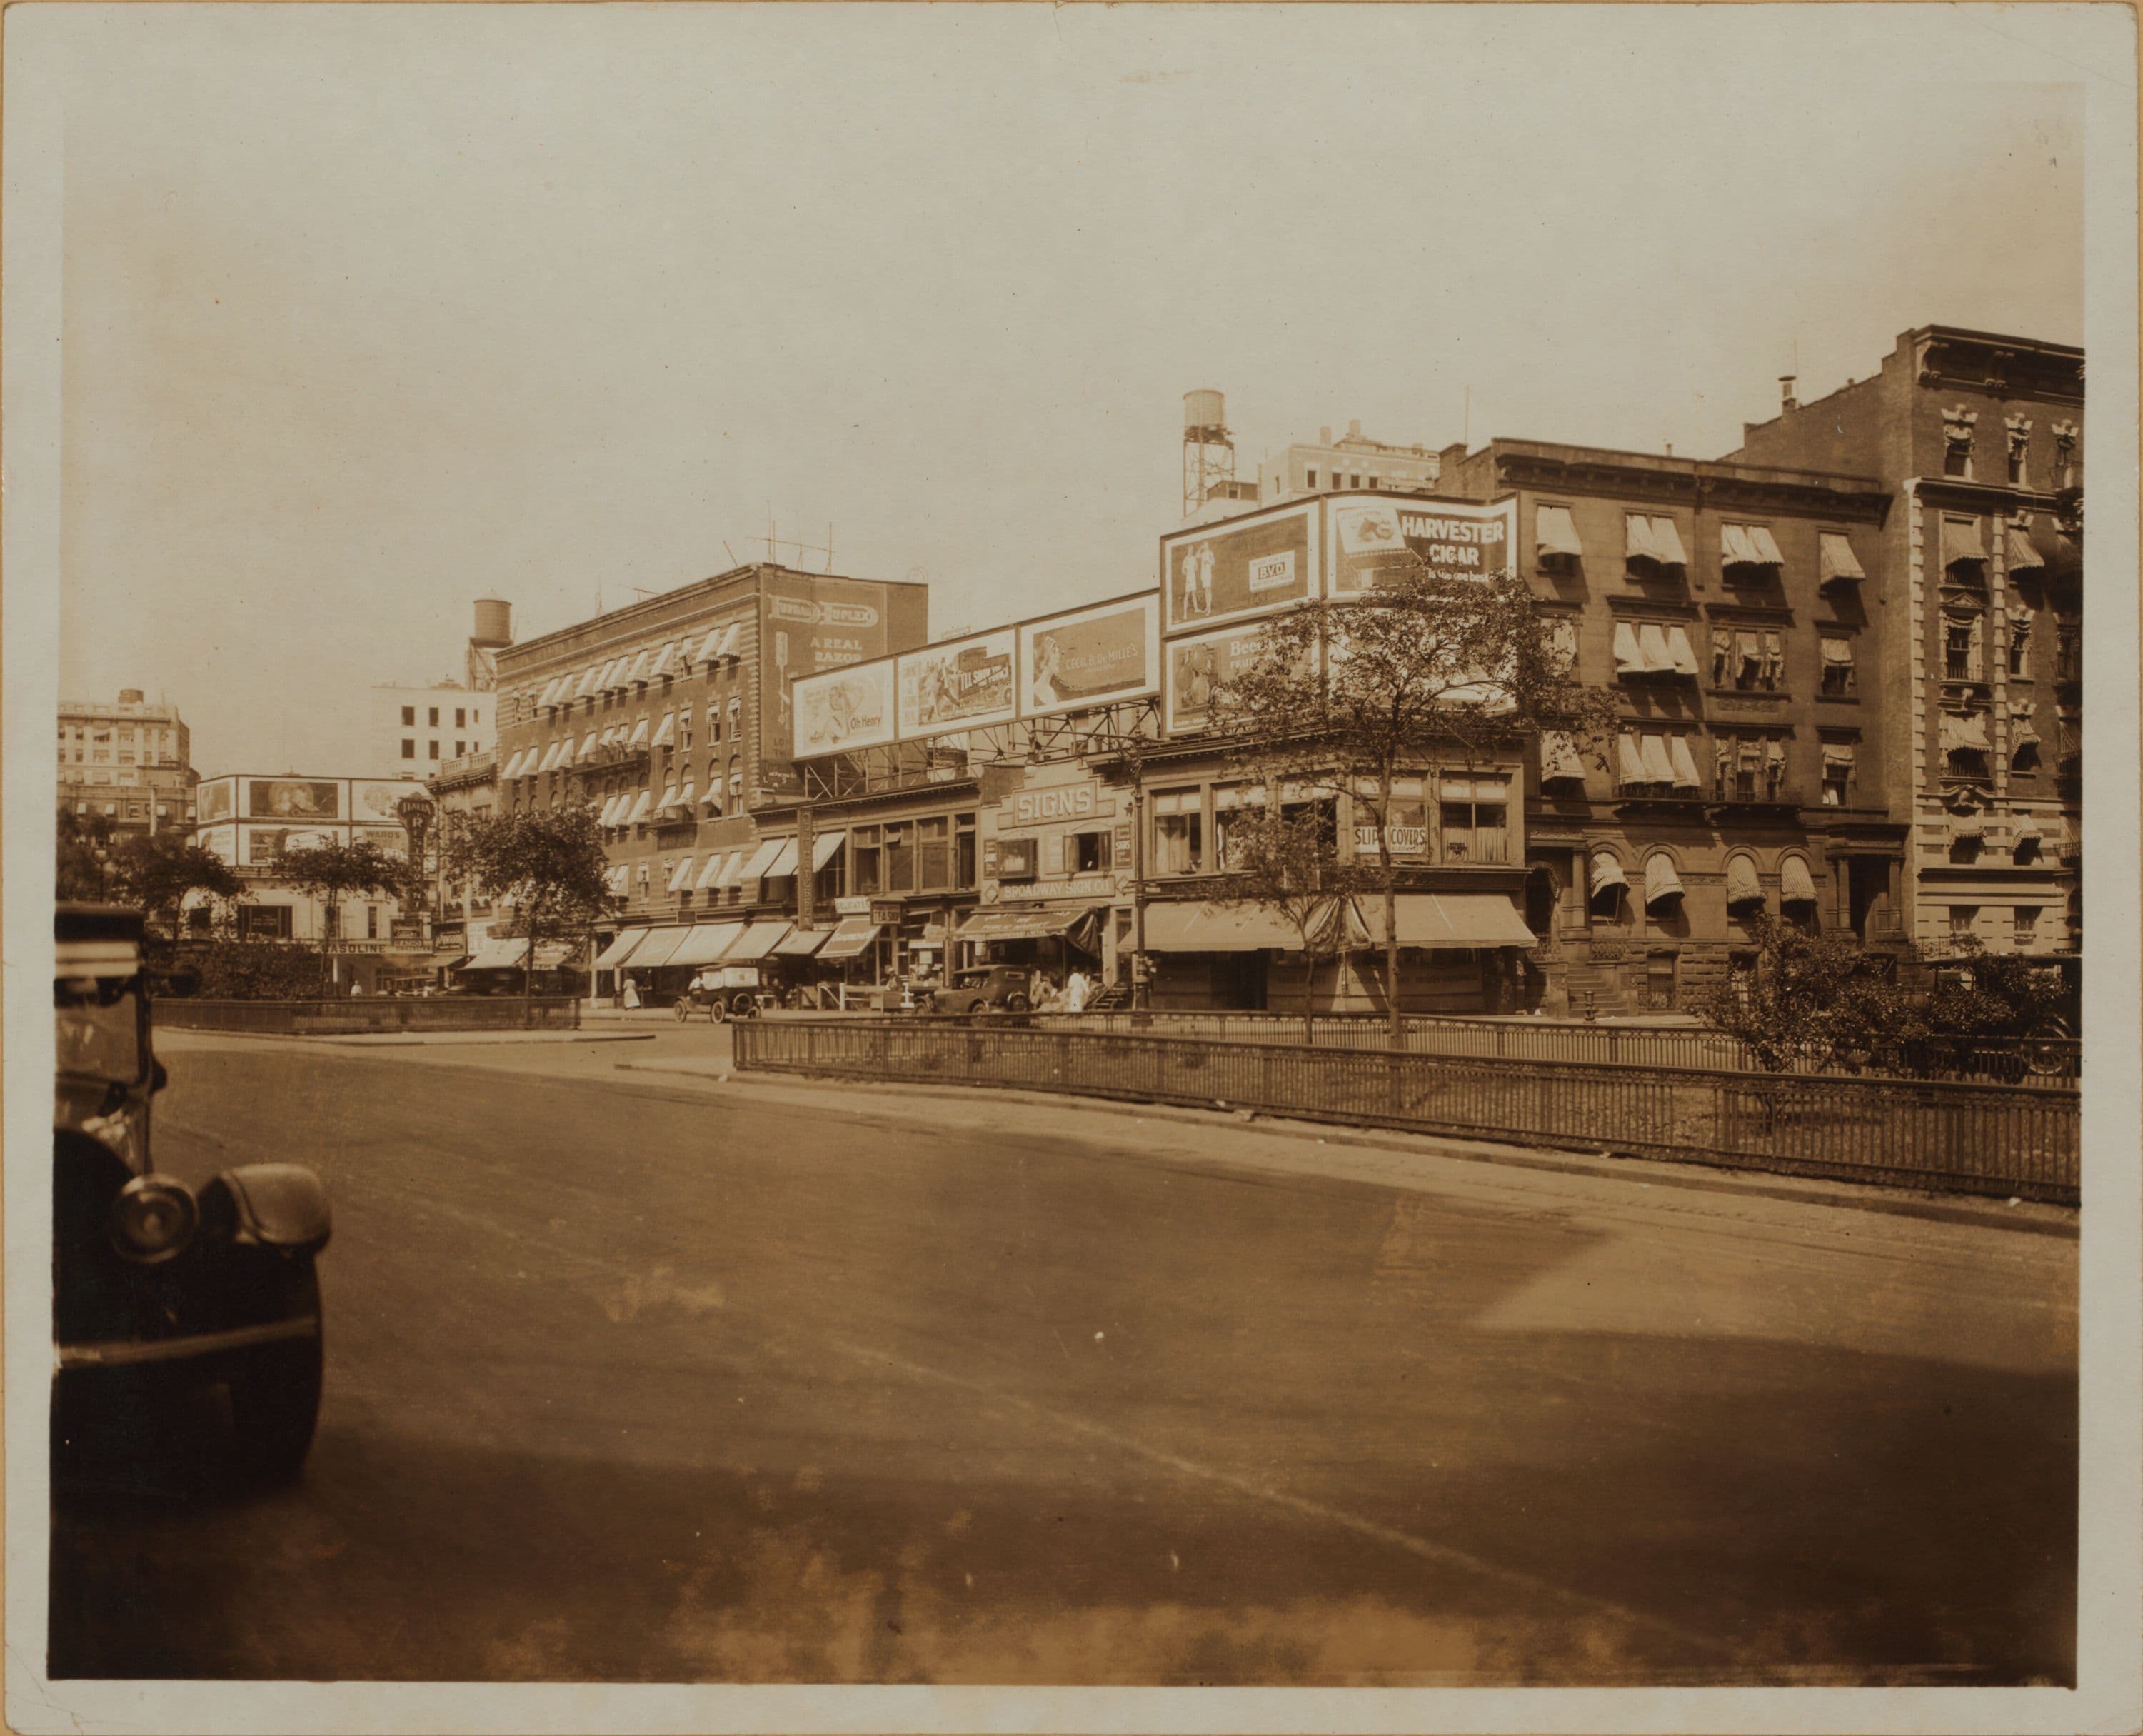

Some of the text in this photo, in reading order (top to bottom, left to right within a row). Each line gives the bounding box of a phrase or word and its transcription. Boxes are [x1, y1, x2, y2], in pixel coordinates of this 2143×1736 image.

[1401, 516, 1505, 543] HARVESTER
[1428, 543, 1480, 566] CIGAR
[810, 637, 863, 651] A REAL
[814, 651, 863, 663] RAZOR
[1018, 786, 1091, 821] SIGNS
[1355, 828, 1426, 846] SLIP COVERS
[1004, 883, 1061, 898] BROADWAY
[1065, 879, 1090, 893] SIGN
[321, 944, 386, 953] GASOLINE
